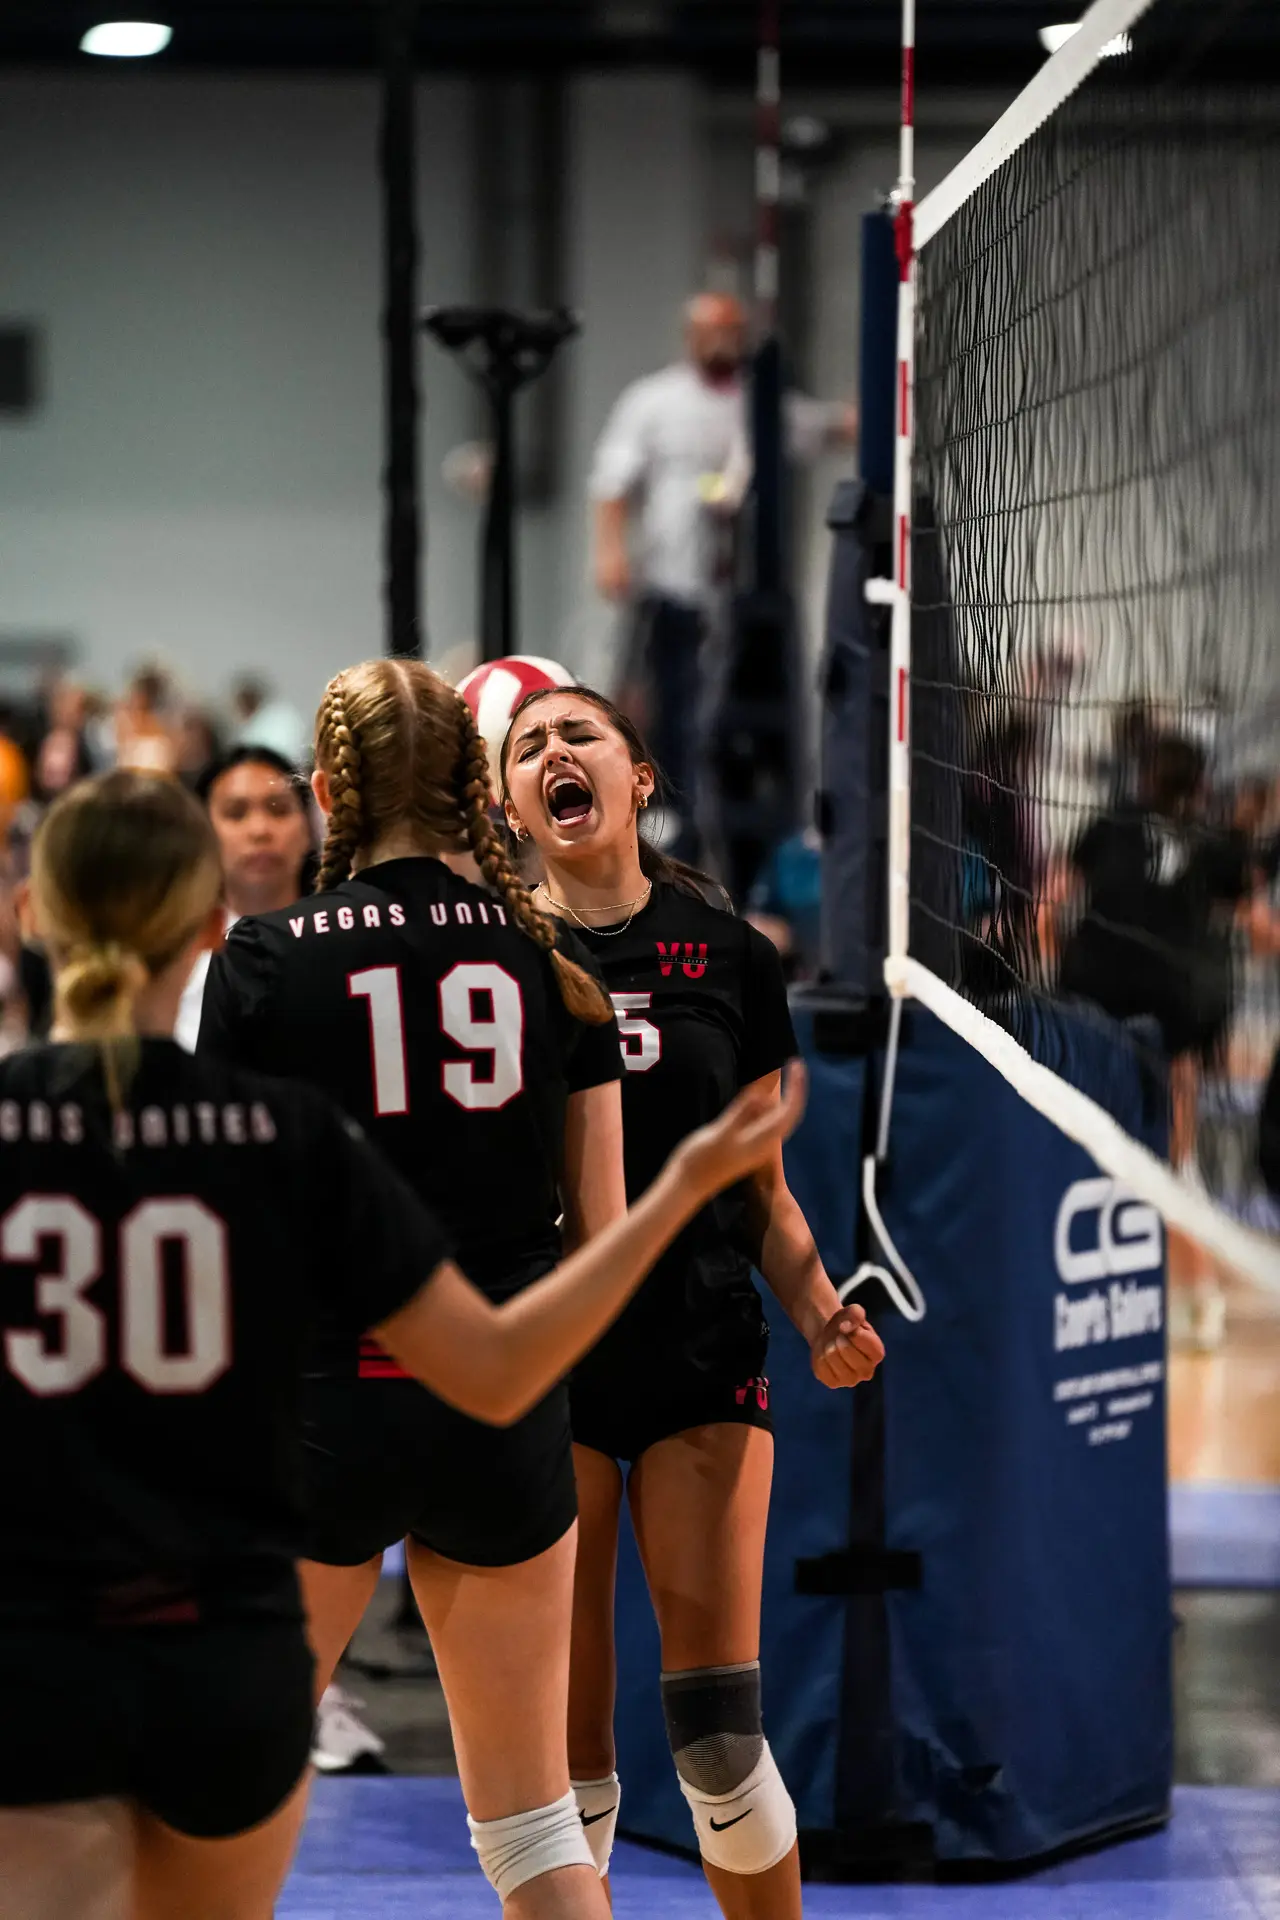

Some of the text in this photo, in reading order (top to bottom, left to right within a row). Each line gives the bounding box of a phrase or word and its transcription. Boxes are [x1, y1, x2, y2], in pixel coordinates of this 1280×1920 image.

[288, 902, 507, 938] VEGAS UNIT
[655, 941, 708, 979] VU
[346, 961, 525, 1117] 19
[609, 991, 662, 1071] 5
[0, 1192, 233, 1397] 30
